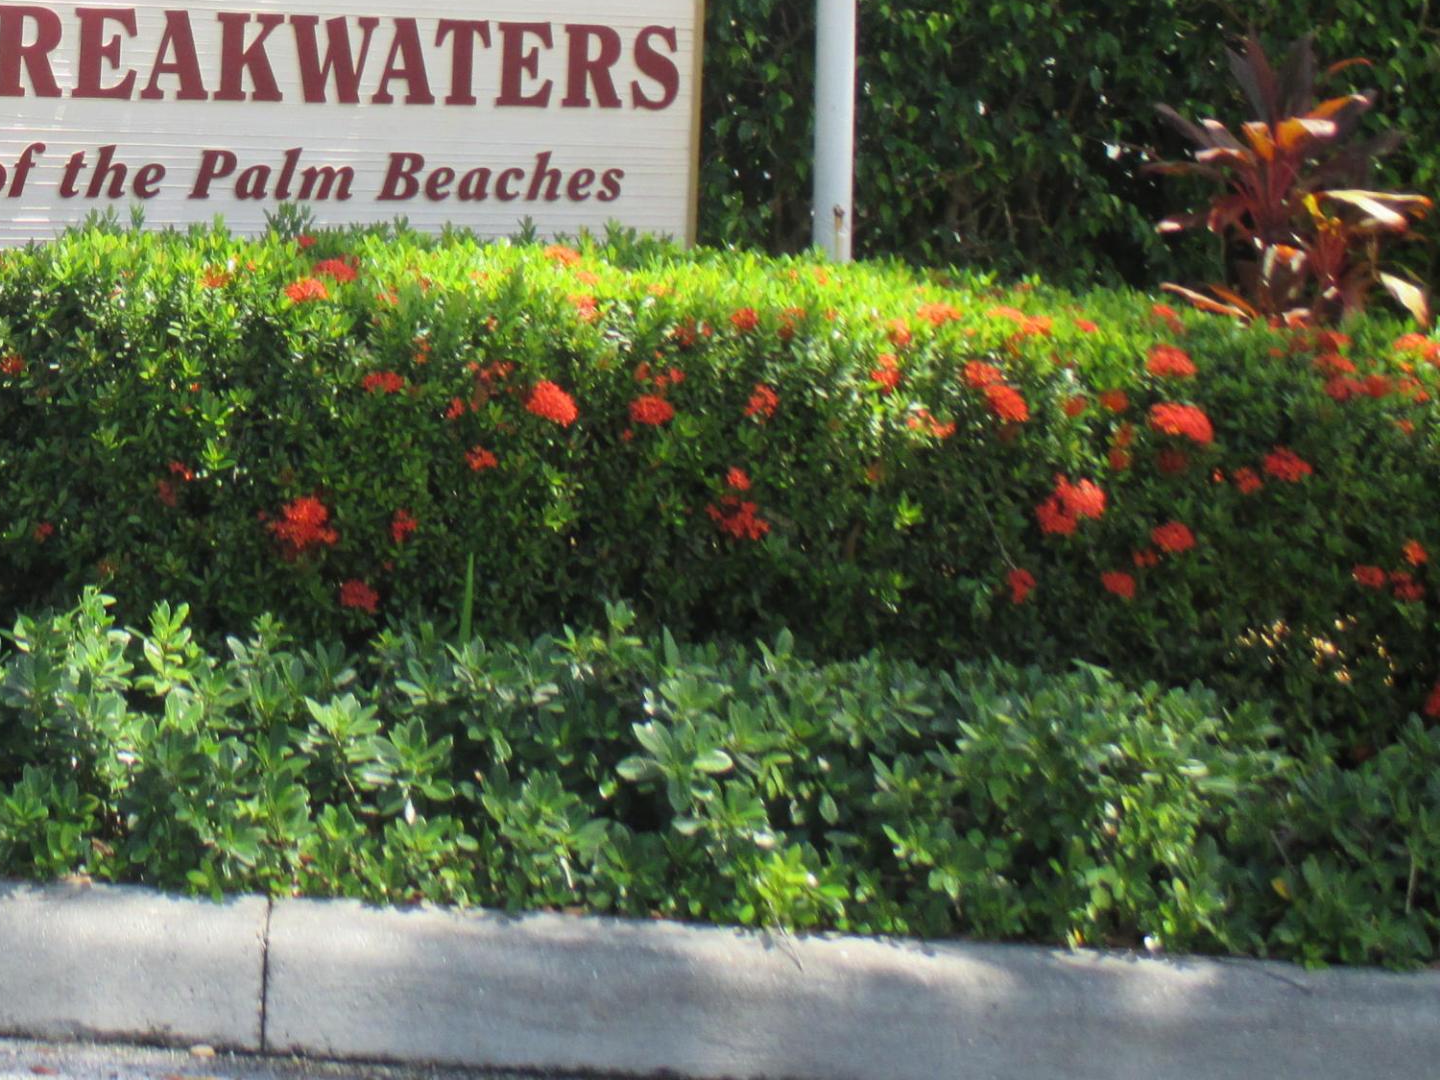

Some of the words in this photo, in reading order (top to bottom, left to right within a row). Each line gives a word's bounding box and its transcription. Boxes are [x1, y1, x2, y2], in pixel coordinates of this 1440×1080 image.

[58, 144, 166, 200] the
[187, 147, 355, 201] Palm
[375, 151, 625, 203] Beaches
